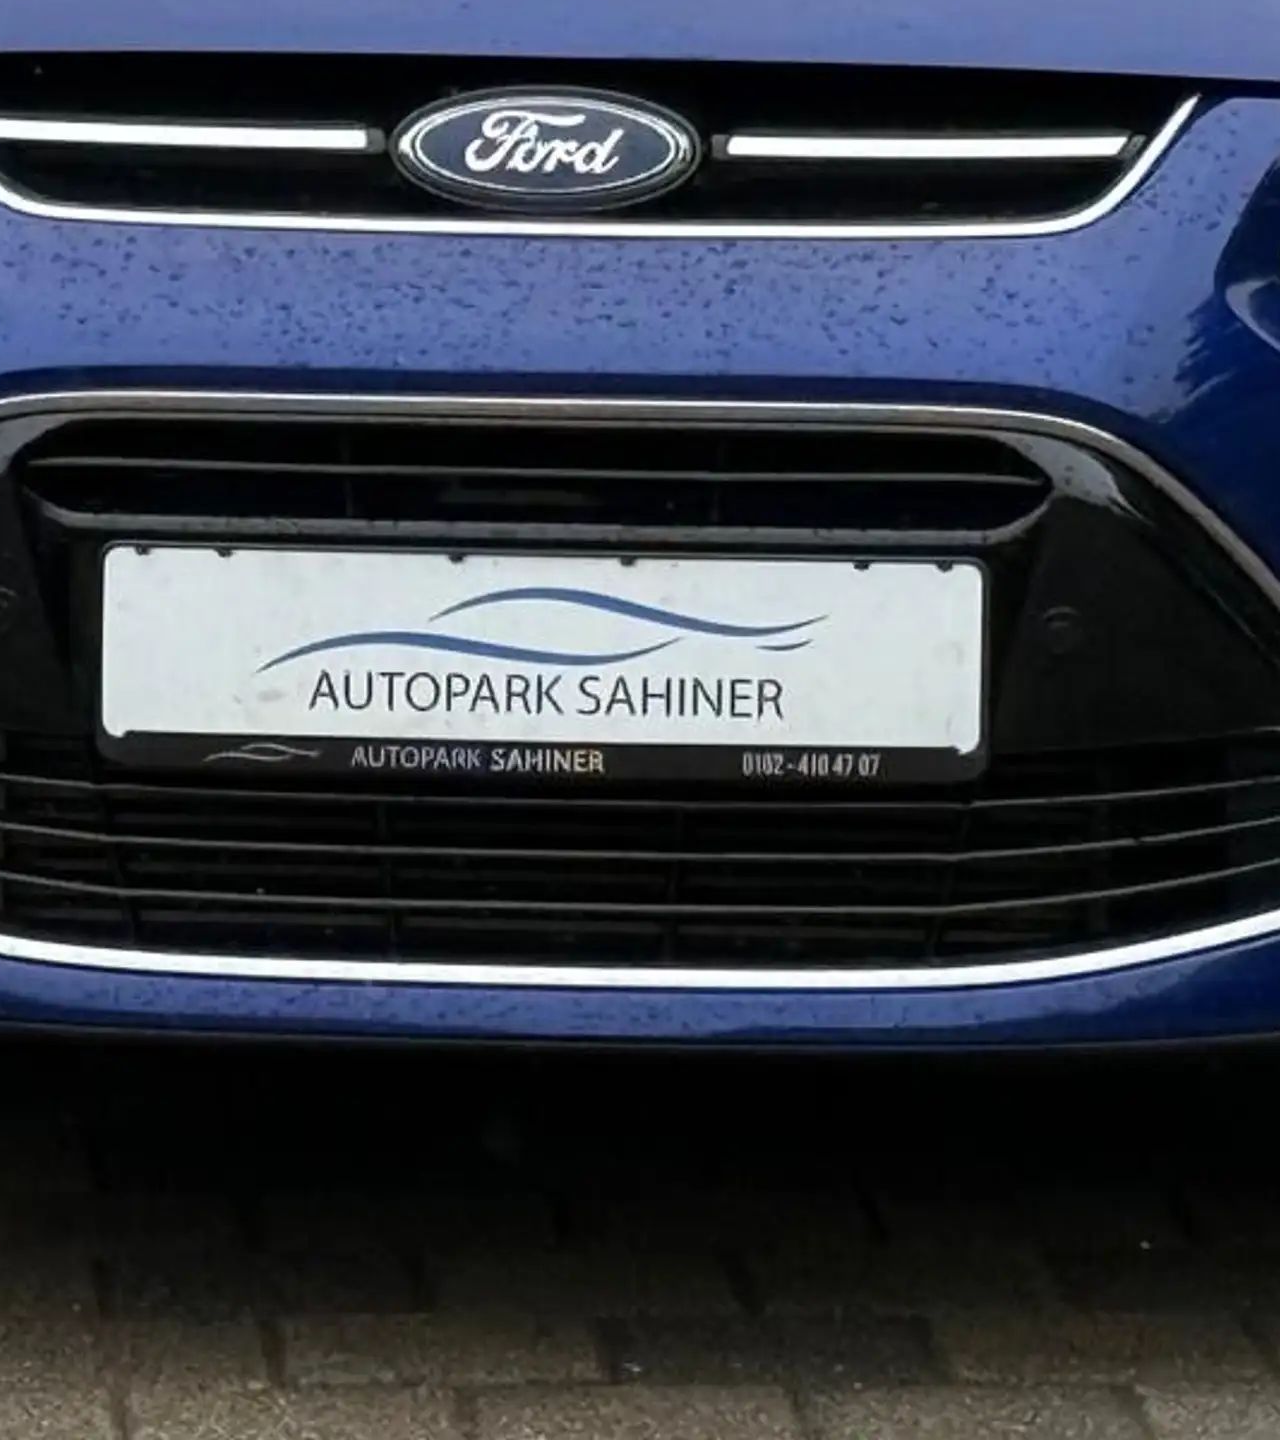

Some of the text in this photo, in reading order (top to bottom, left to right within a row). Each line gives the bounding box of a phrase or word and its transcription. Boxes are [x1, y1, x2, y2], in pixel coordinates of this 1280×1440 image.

[463, 109, 624, 175] Ford
[308, 667, 785, 721] AUTOPARK SAHINER
[351, 745, 606, 773] AUTOPARK SAHINER
